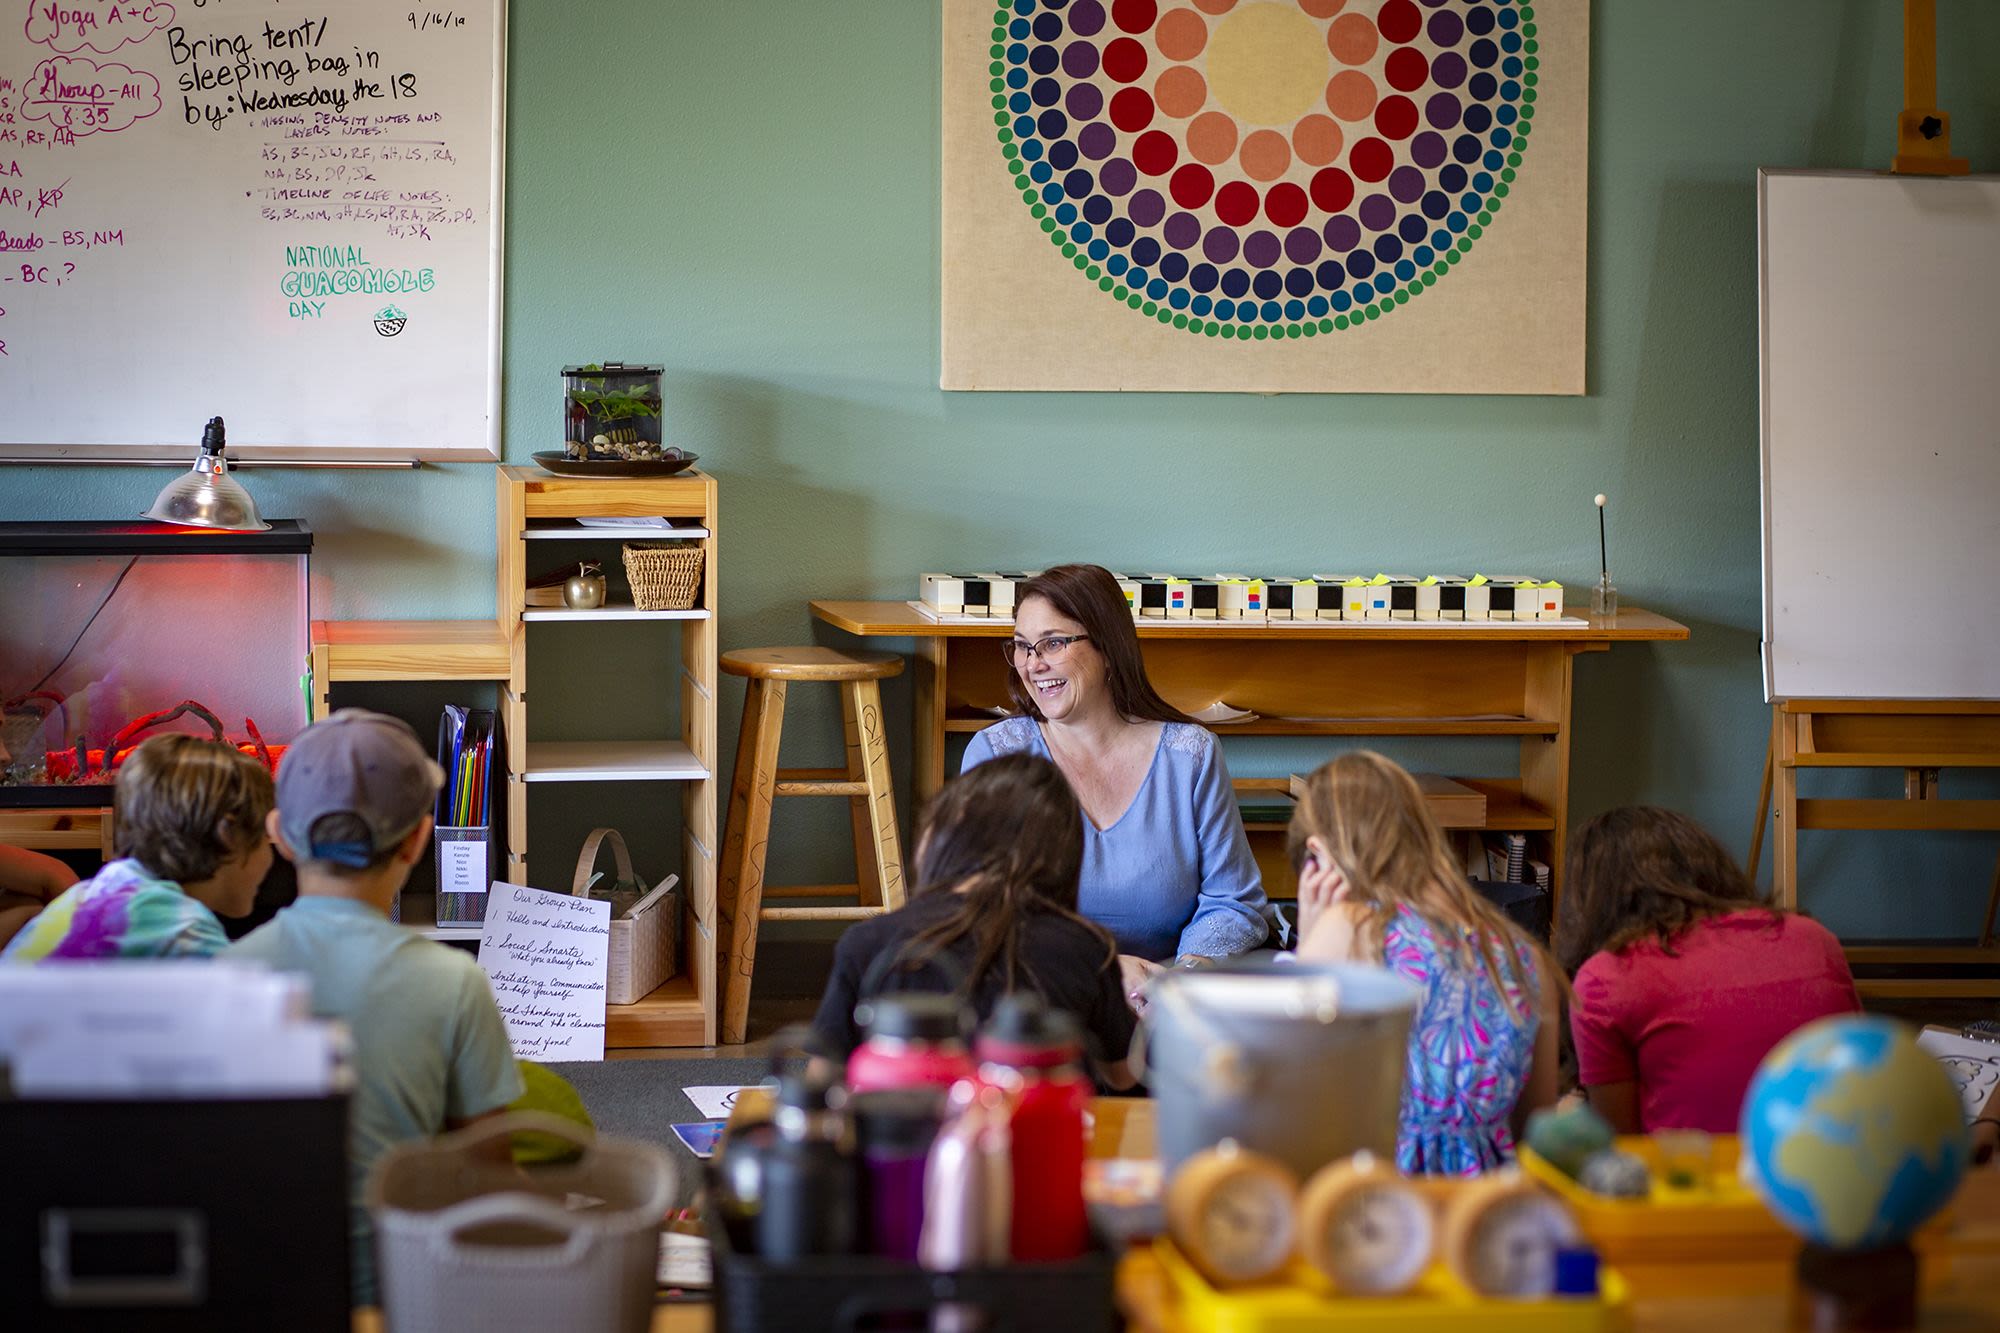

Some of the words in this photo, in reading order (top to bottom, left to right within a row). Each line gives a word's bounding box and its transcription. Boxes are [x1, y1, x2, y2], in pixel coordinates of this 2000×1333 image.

[44, 2, 98, 39] Yoga
[168, 27, 252, 65] Bring
[263, 17, 328, 50] tent/
[178, 57, 300, 93] sleeping
[305, 52, 350, 77] bag
[354, 46, 379, 69] in
[237, 86, 349, 113] Wednesday
[353, 78, 385, 100] the
[391, 73, 417, 99] 18
[63, 106, 110, 125] 8:35
[261, 113, 304, 128] MISSING
[315, 112, 368, 126] DENSITY
[375, 114, 410, 124] NOTES
[417, 112, 442, 122] AND
[285, 125, 330, 138] LAYERS
[343, 189, 361, 200] OF
[364, 189, 392, 201] LIFE
[94, 229, 123, 246] NM
[286, 245, 370, 268] NATIONAL
[281, 268, 435, 297] GUACOMOLE
[289, 301, 325, 320] DAY
[513, 888, 531, 903] Our
[535, 894, 566, 911] Group
[568, 899, 596, 915] Plan
[506, 910, 530, 925] Hello
[532, 918, 551, 928] and
[498, 933, 537, 953] Social
[538, 940, 583, 958] Smarts
[530, 954, 545, 967] you
[546, 956, 574, 969] already
[491, 970, 545, 987] Initiating
[509, 985, 530, 997] help
[533, 988, 574, 1001] yourself
[520, 1004, 566, 1019] Thinking
[567, 1010, 581, 1019] in
[510, 1017, 544, 1028] around
[550, 1017, 567, 1028] the
[521, 1036, 542, 1047] and
